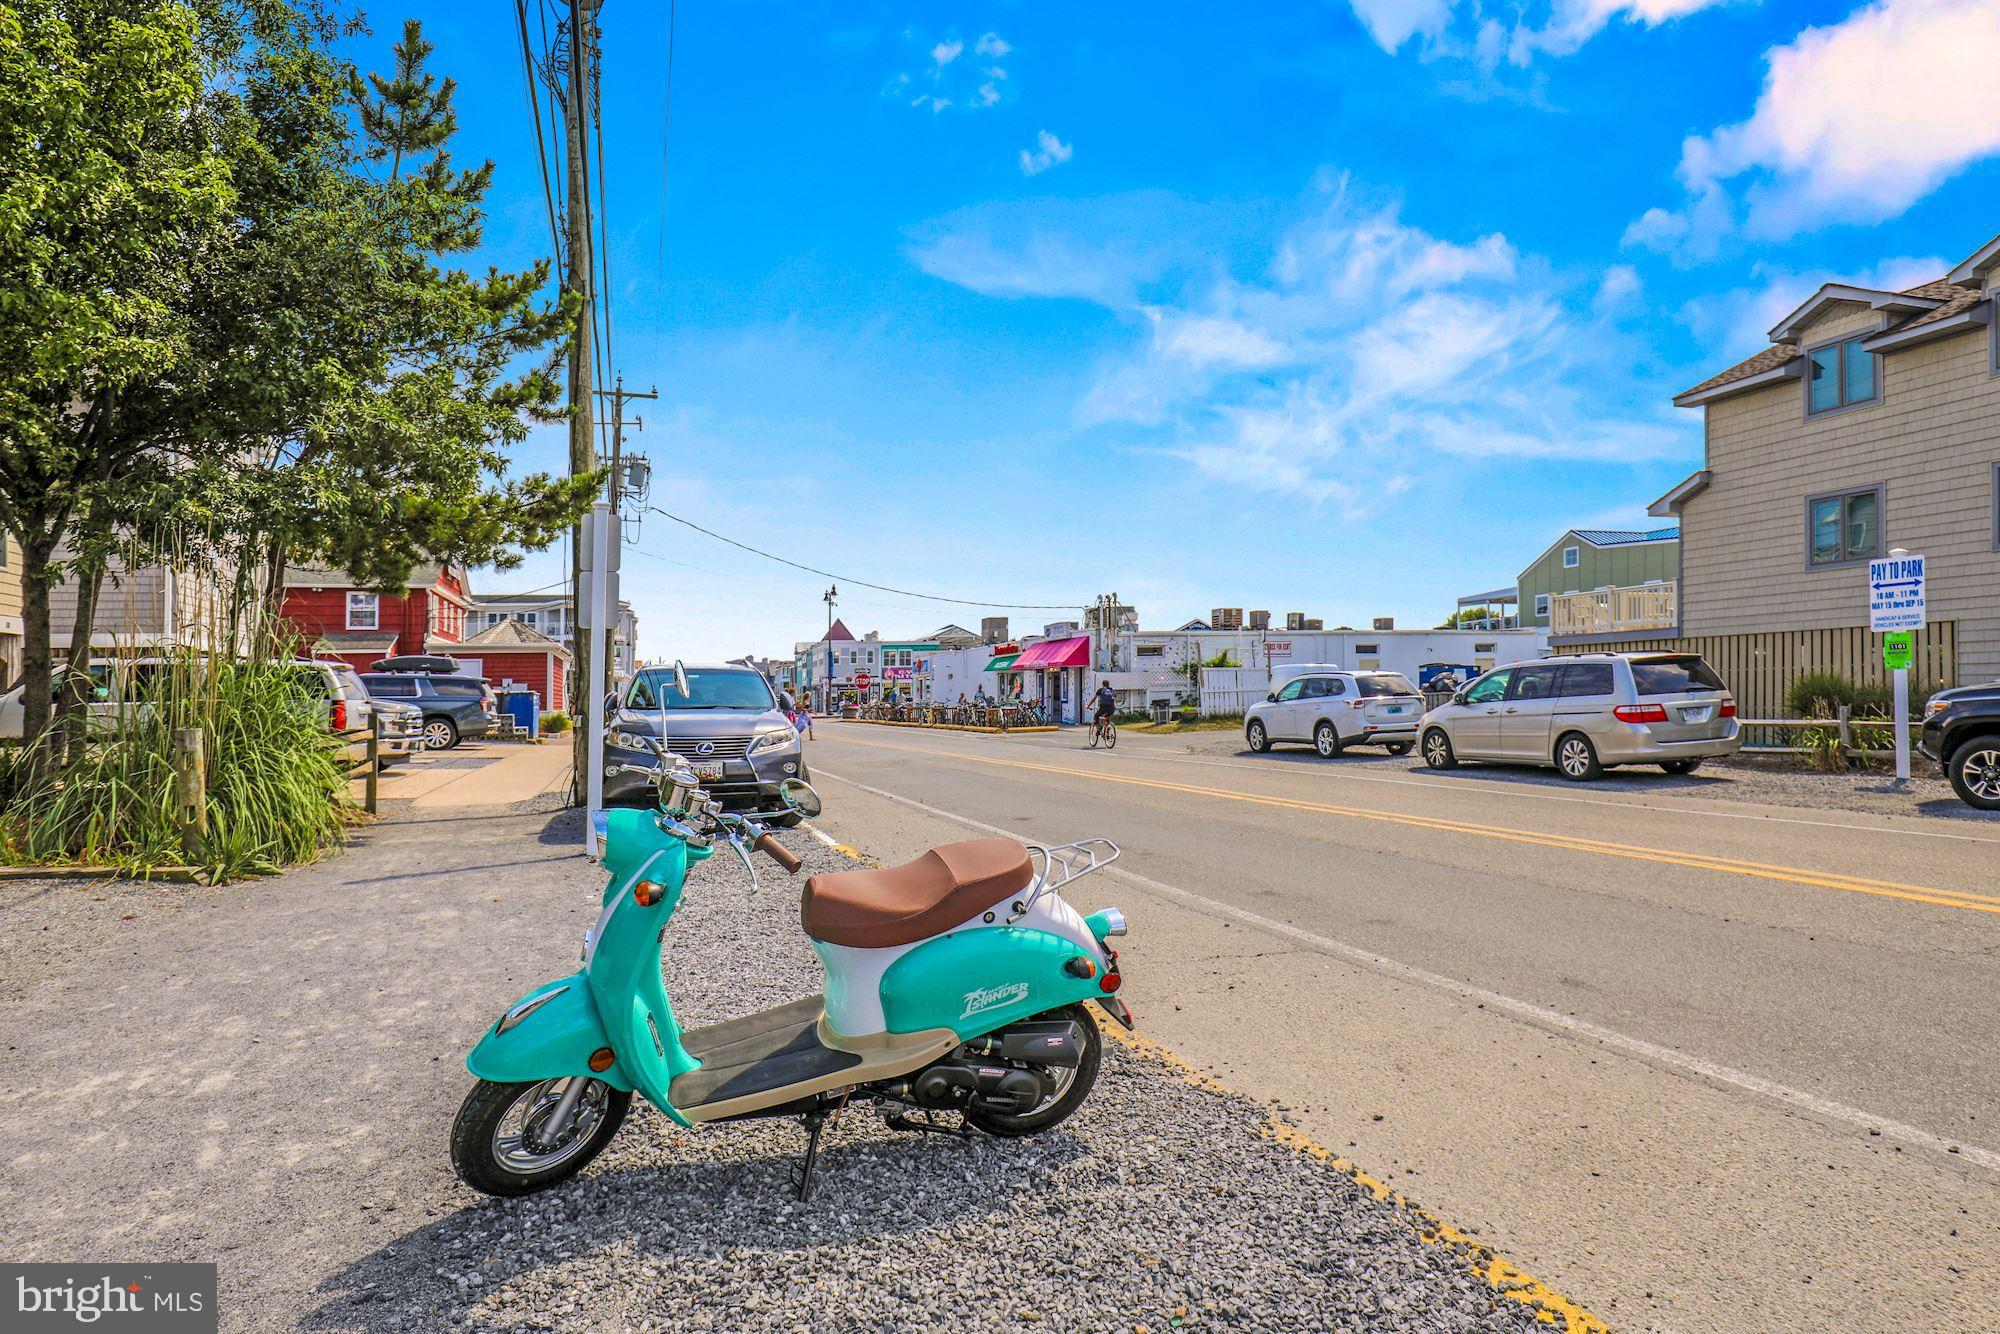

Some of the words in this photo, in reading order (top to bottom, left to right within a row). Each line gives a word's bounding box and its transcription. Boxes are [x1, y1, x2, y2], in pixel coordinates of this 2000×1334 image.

[1871, 562, 1887, 581] PAY
[1889, 561, 1899, 580] TO
[1901, 559, 1923, 578] PARK
[1900, 590, 1907, 598] 11
[1909, 589, 1919, 597] PM
[1886, 601, 1892, 609] 15
[1905, 599, 1915, 607] SEP
